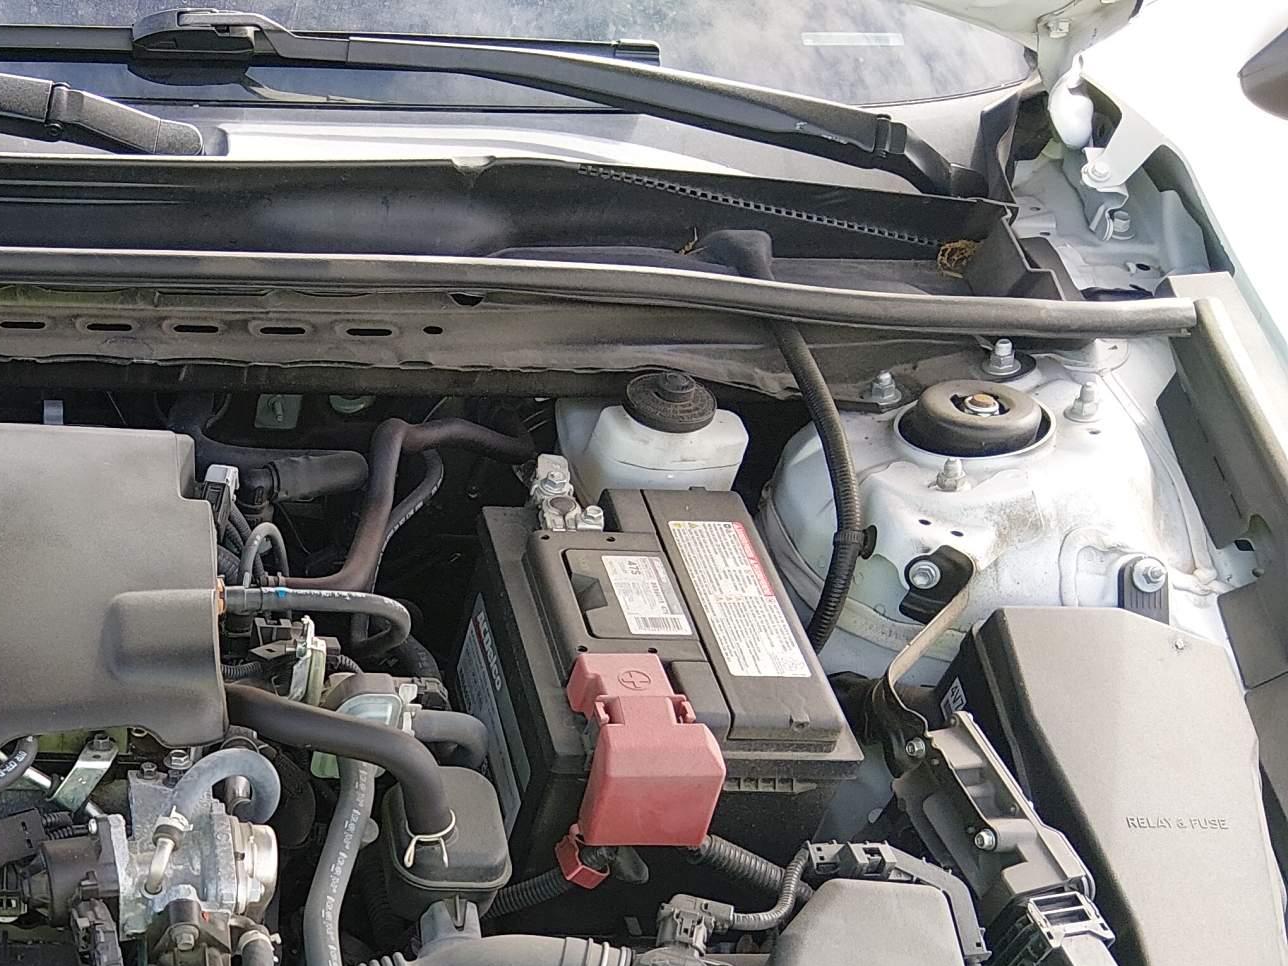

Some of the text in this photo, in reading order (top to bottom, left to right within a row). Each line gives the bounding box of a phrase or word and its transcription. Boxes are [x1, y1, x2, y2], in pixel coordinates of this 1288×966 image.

[1126, 816, 1229, 830] RELAY & FUSE
